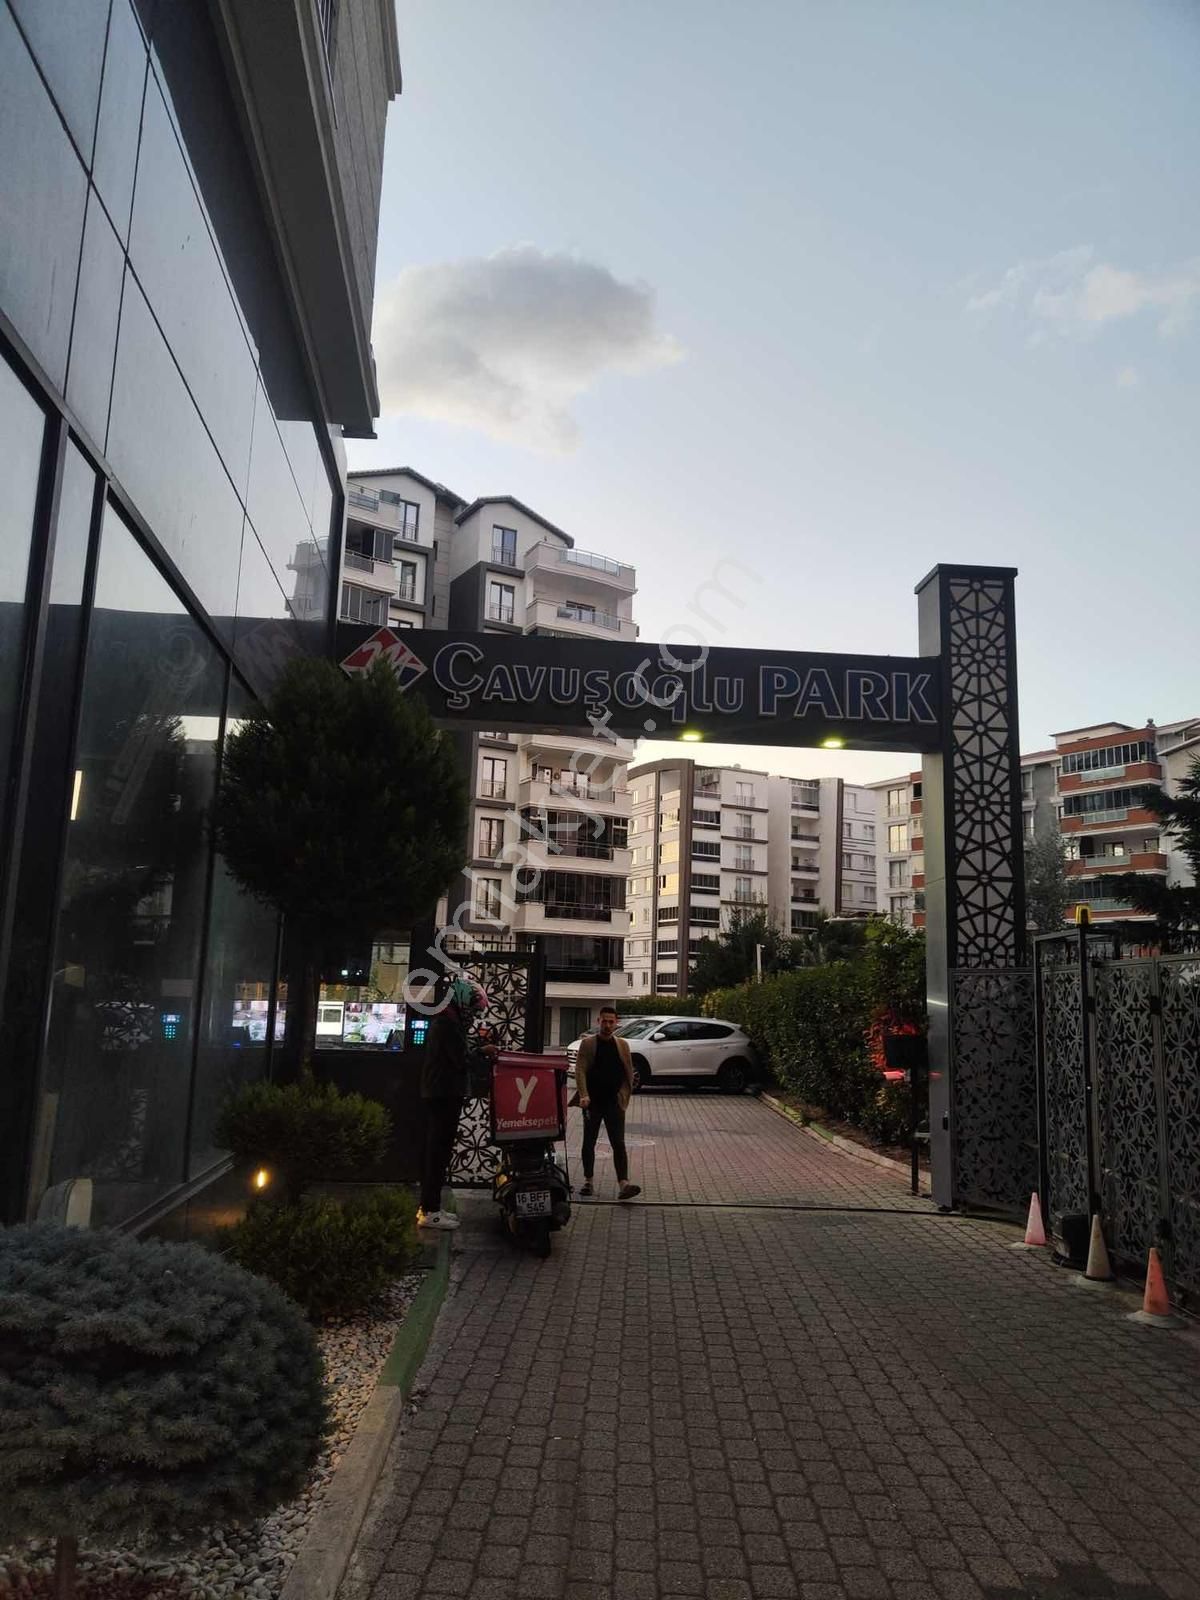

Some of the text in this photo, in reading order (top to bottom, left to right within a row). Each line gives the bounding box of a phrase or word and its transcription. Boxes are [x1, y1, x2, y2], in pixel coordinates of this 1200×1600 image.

[759, 664, 938, 724] PARK
[515, 1075, 539, 1114] Y
[496, 1115, 558, 1131] Yemeksepeti
[517, 1193, 527, 1203] 16
